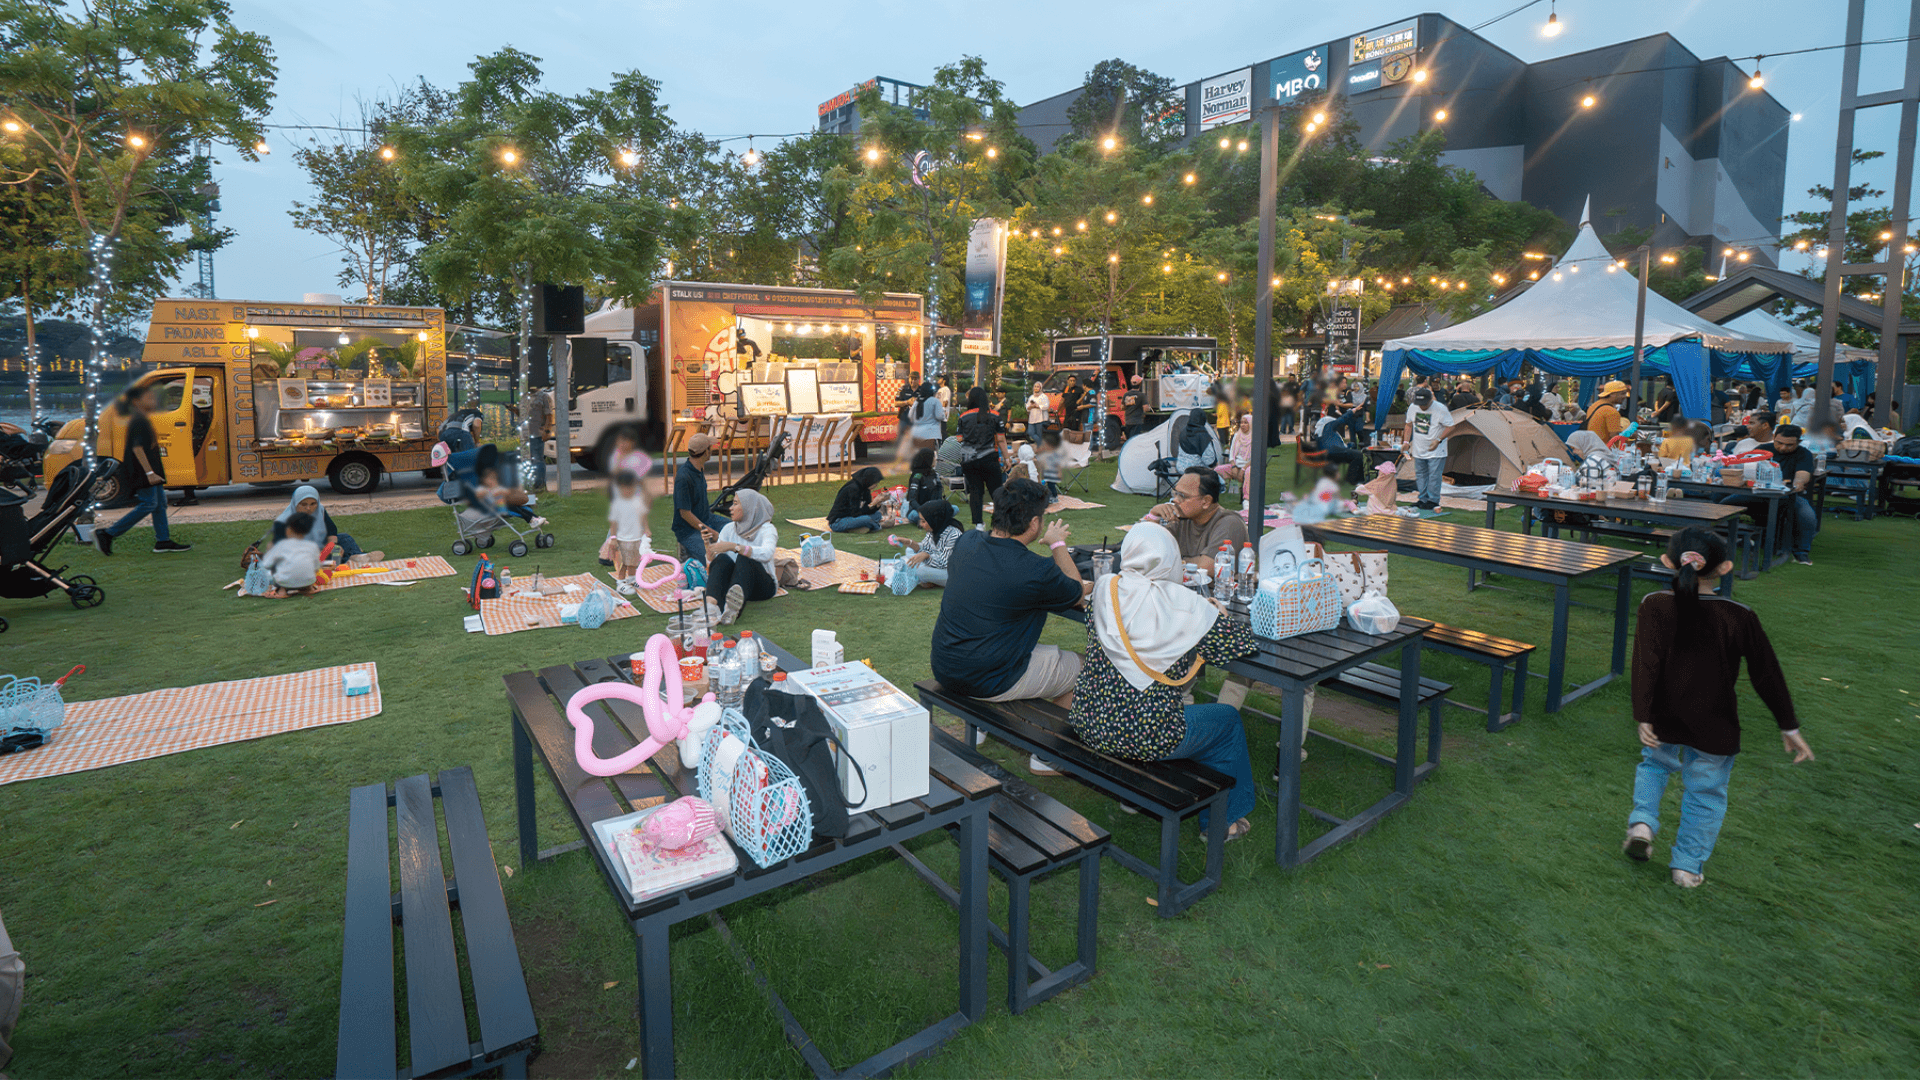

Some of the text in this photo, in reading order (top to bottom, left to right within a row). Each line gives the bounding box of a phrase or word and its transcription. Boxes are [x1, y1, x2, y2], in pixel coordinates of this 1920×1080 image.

[1204, 79, 1247, 99] Harvey
[1276, 74, 1320, 100] MBO
[818, 91, 850, 116] GAMUDA
[1203, 95, 1248, 116] Norman
[672, 290, 692, 298] STALK
[175, 308, 220, 320] NASI
[164, 327, 225, 339] PADANG
[182, 346, 221, 358] ASLI
[263, 459, 318, 476] PADANG
